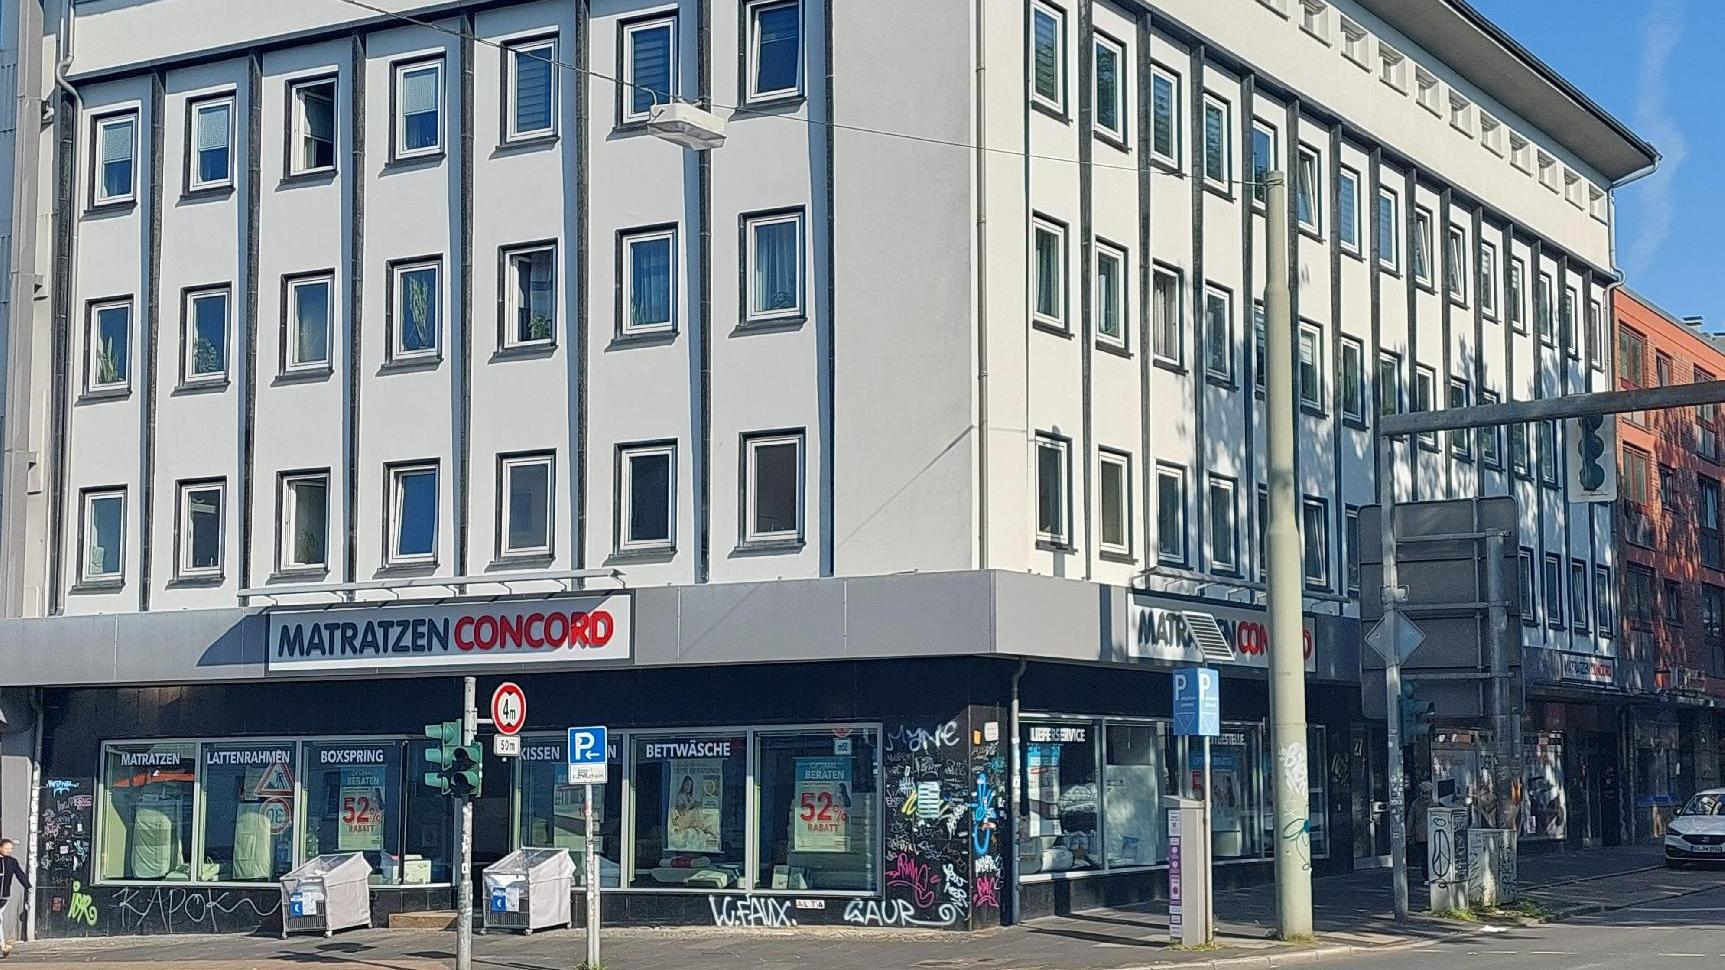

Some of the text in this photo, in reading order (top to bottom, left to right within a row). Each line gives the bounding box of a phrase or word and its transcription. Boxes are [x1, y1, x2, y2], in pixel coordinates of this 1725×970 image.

[277, 611, 614, 657] MATRATZEN CONCORD
[575, 732, 595, 760] P
[646, 740, 731, 758] BETTWÄSCHE
[121, 753, 181, 766] MATRATZEN
[207, 751, 290, 765] LATTENRAHMEN
[320, 749, 384, 763] BOXSPRING
[805, 770, 845, 780] BERATEN
[808, 823, 838, 832] RABATT
